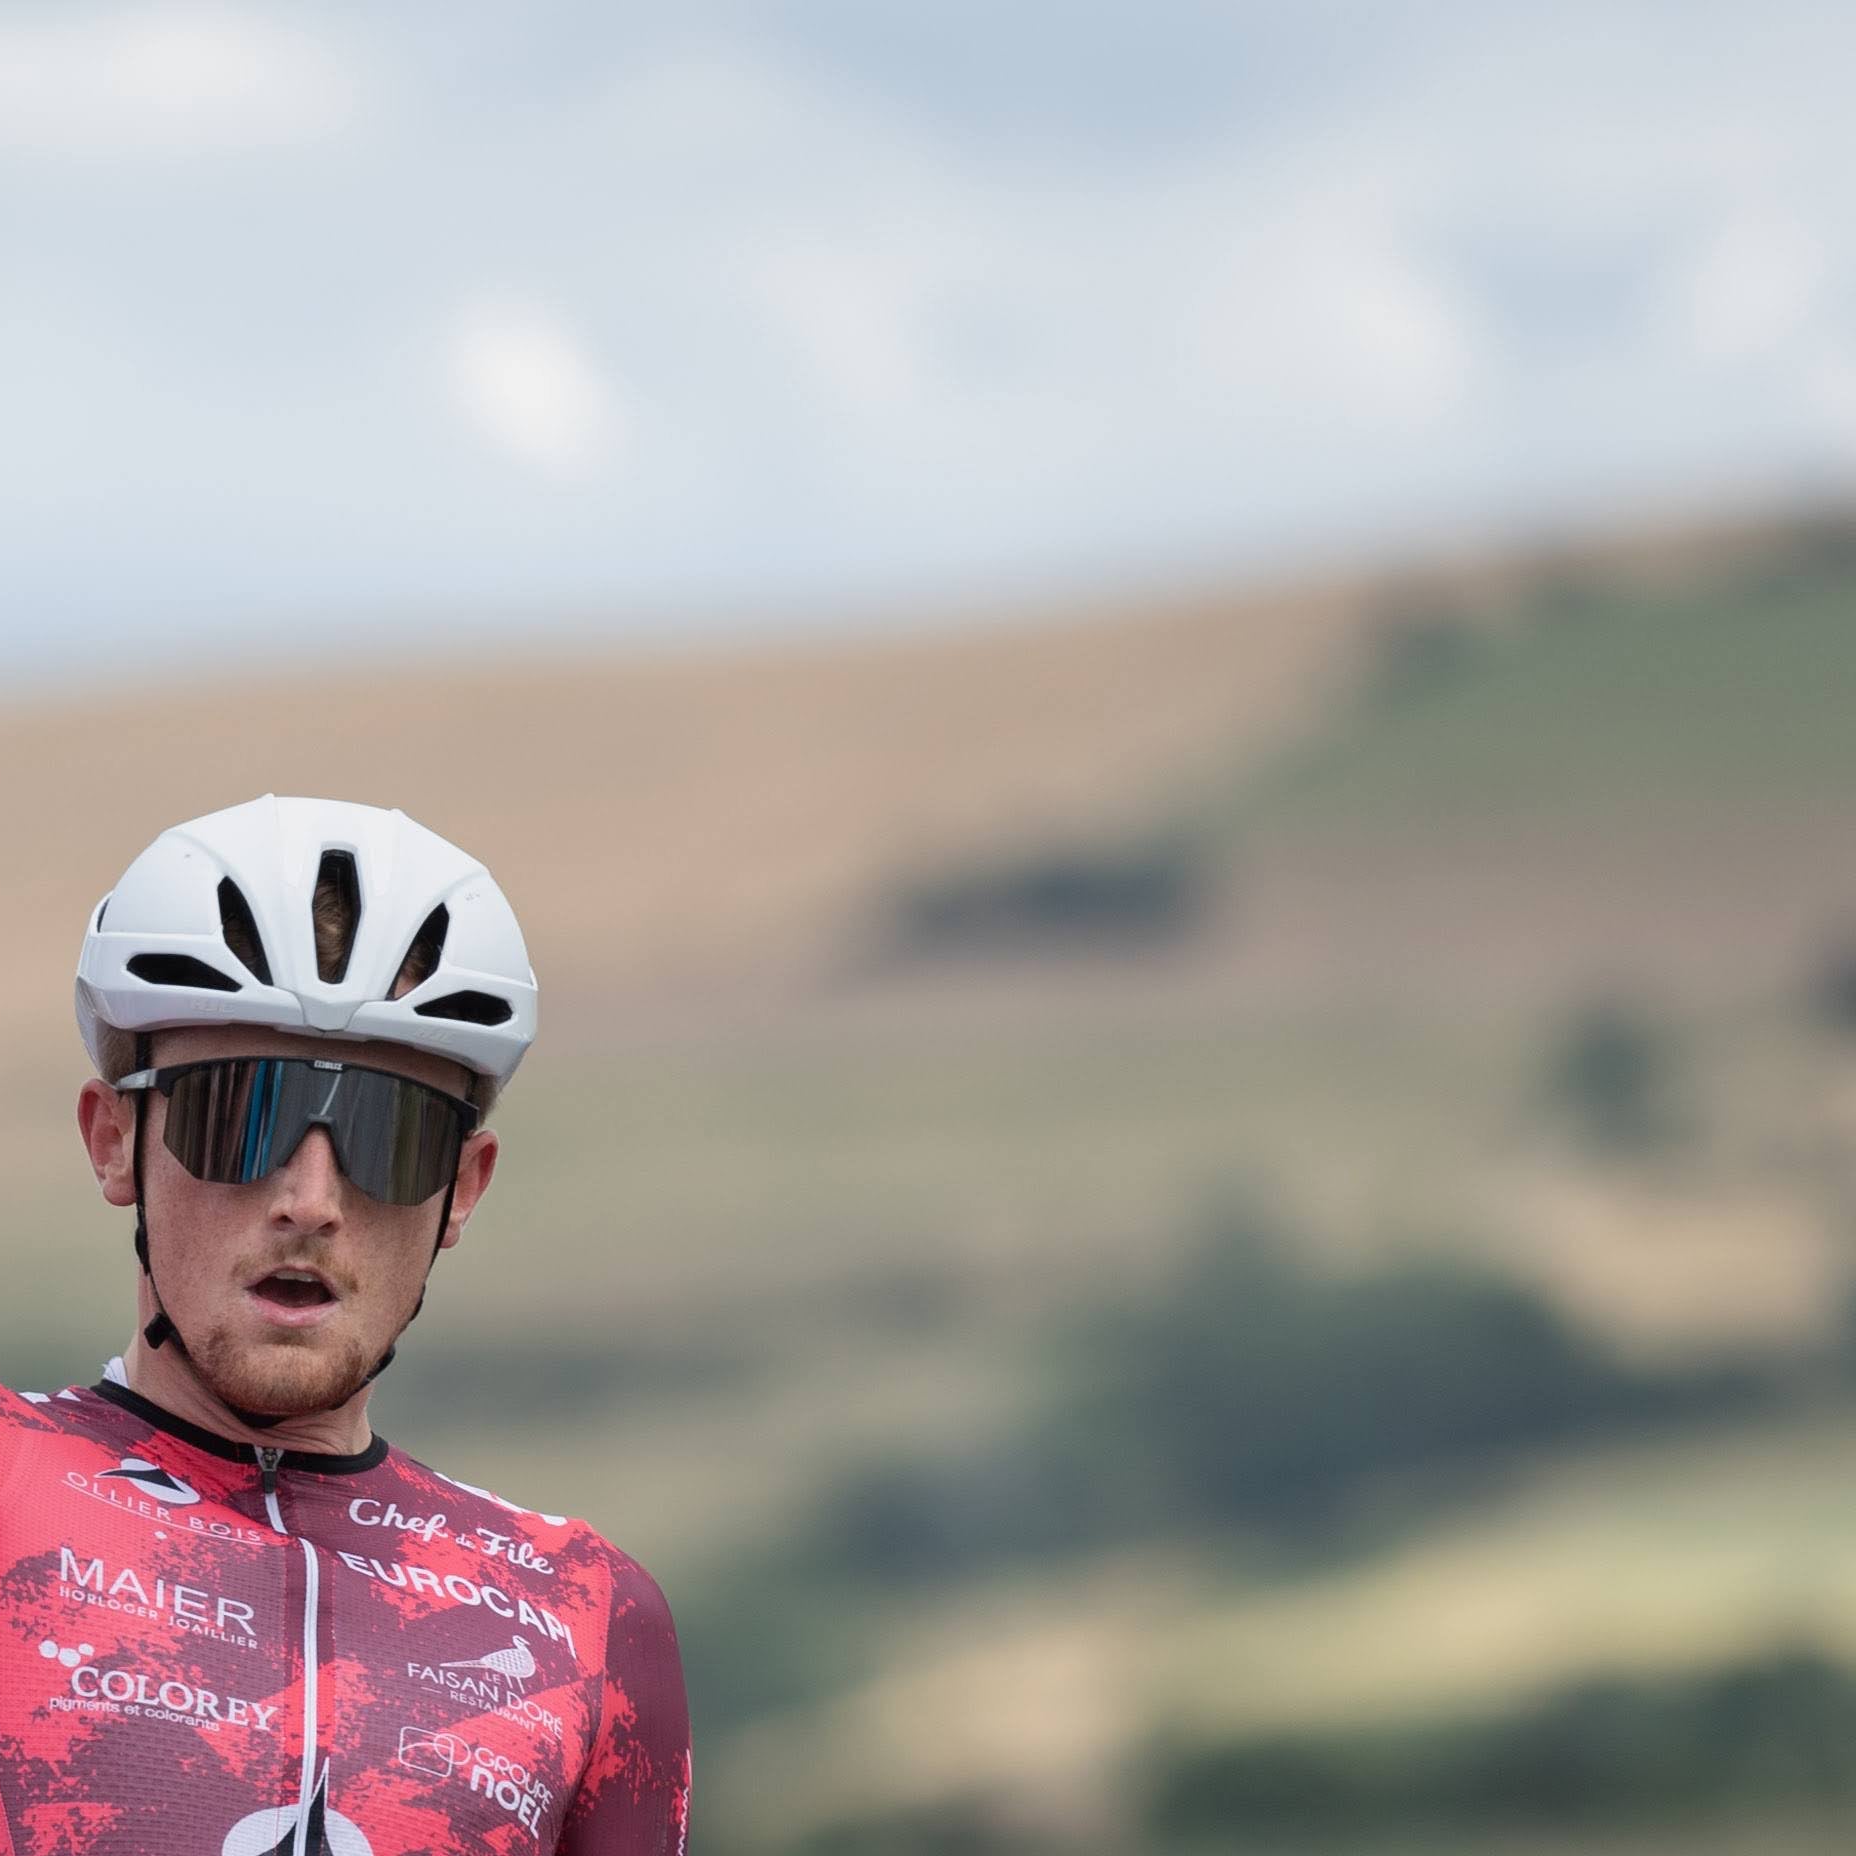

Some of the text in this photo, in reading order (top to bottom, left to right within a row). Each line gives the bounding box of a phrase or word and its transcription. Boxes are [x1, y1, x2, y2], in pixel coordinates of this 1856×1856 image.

[67, 1471, 262, 1541] OLLIER BOIS
[348, 1498, 554, 1575] Chef de File
[59, 1586, 258, 1650] HORLOGER JOAILLIER
[61, 1546, 256, 1636] MAIER
[49, 1695, 220, 1733] pigments et colorants
[71, 1666, 278, 1731] COLOREY
[407, 1662, 499, 1703] FAISAN
[450, 1690, 537, 1733] RESTAURANT
[474, 1746, 554, 1814] GROUPE
